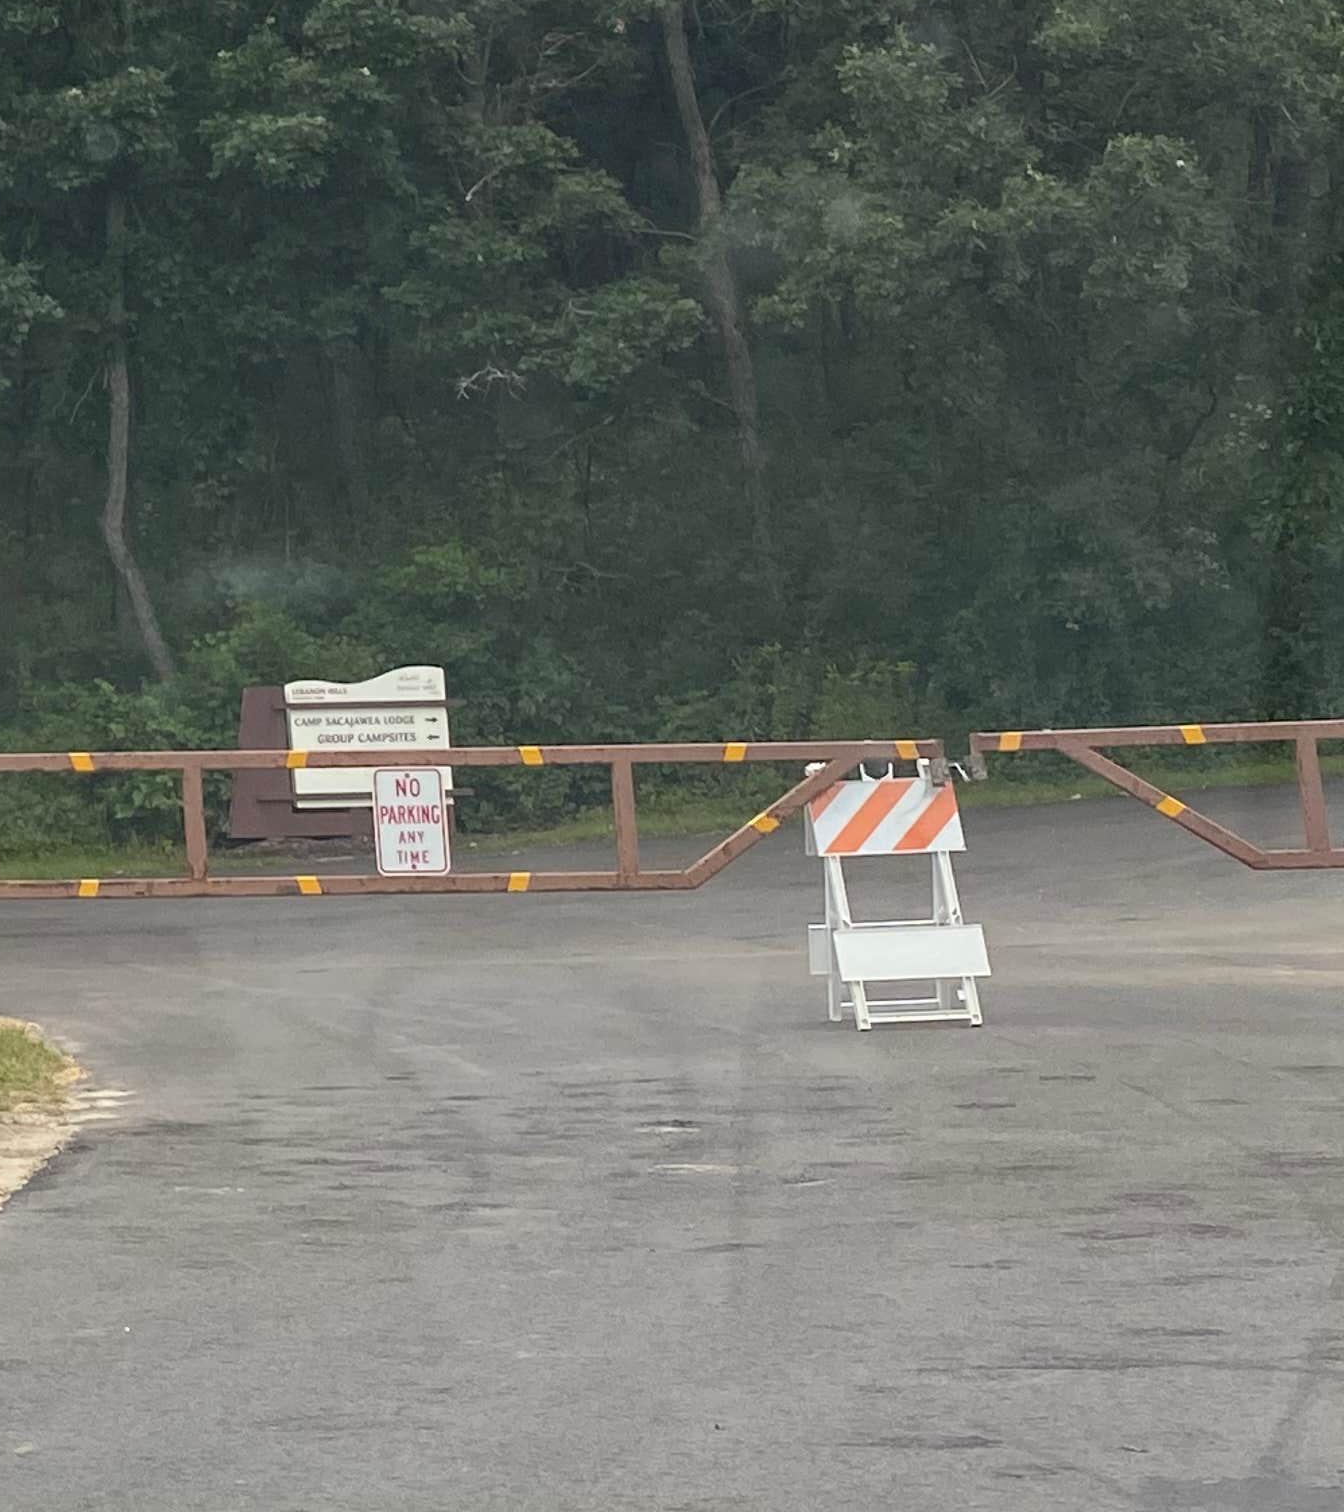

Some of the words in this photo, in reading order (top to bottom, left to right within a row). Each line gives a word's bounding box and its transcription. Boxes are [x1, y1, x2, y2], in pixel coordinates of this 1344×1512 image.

[294, 717, 322, 727] CAMP
[326, 716, 381, 728] SACAJAWEA
[384, 715, 415, 725] LODGE
[317, 733, 354, 744] GROUP
[358, 732, 417, 743] CAMPSITES
[395, 778, 421, 798] NO
[379, 804, 440, 825] PARKING
[398, 830, 425, 844] ANY
[397, 849, 430, 864] TIME
